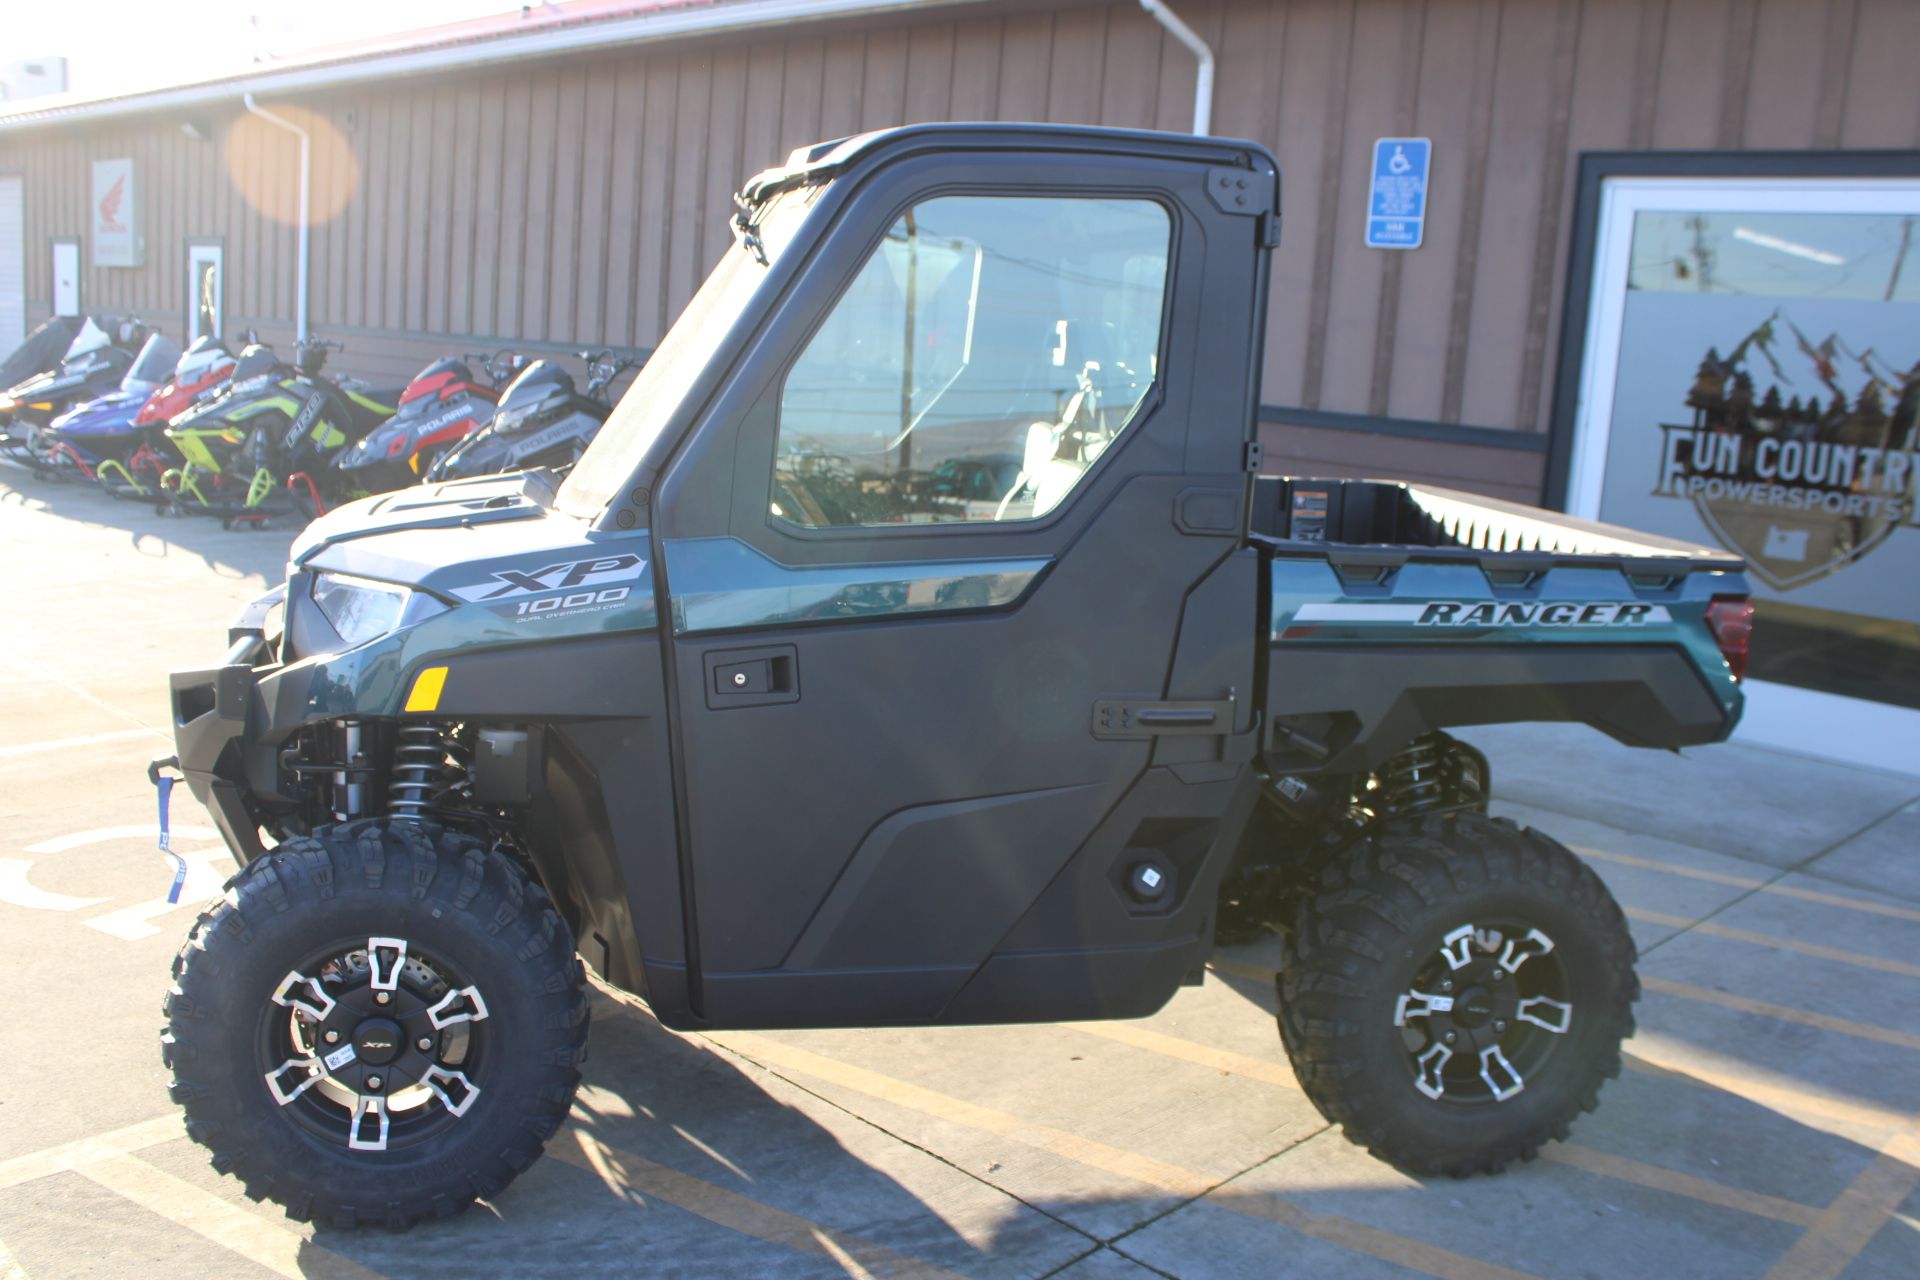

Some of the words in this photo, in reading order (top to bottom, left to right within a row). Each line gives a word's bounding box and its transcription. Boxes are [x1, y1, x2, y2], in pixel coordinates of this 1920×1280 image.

[417, 403, 474, 436] POLARIS
[519, 420, 580, 453] POLARIS
[1653, 425, 1742, 498] FUN
[1754, 436, 1920, 526] COUNTR
[1687, 475, 1907, 522] POWERSPORTS
[480, 553, 645, 601] XP
[517, 587, 631, 616] 1000
[1416, 601, 1651, 627] RANGER
